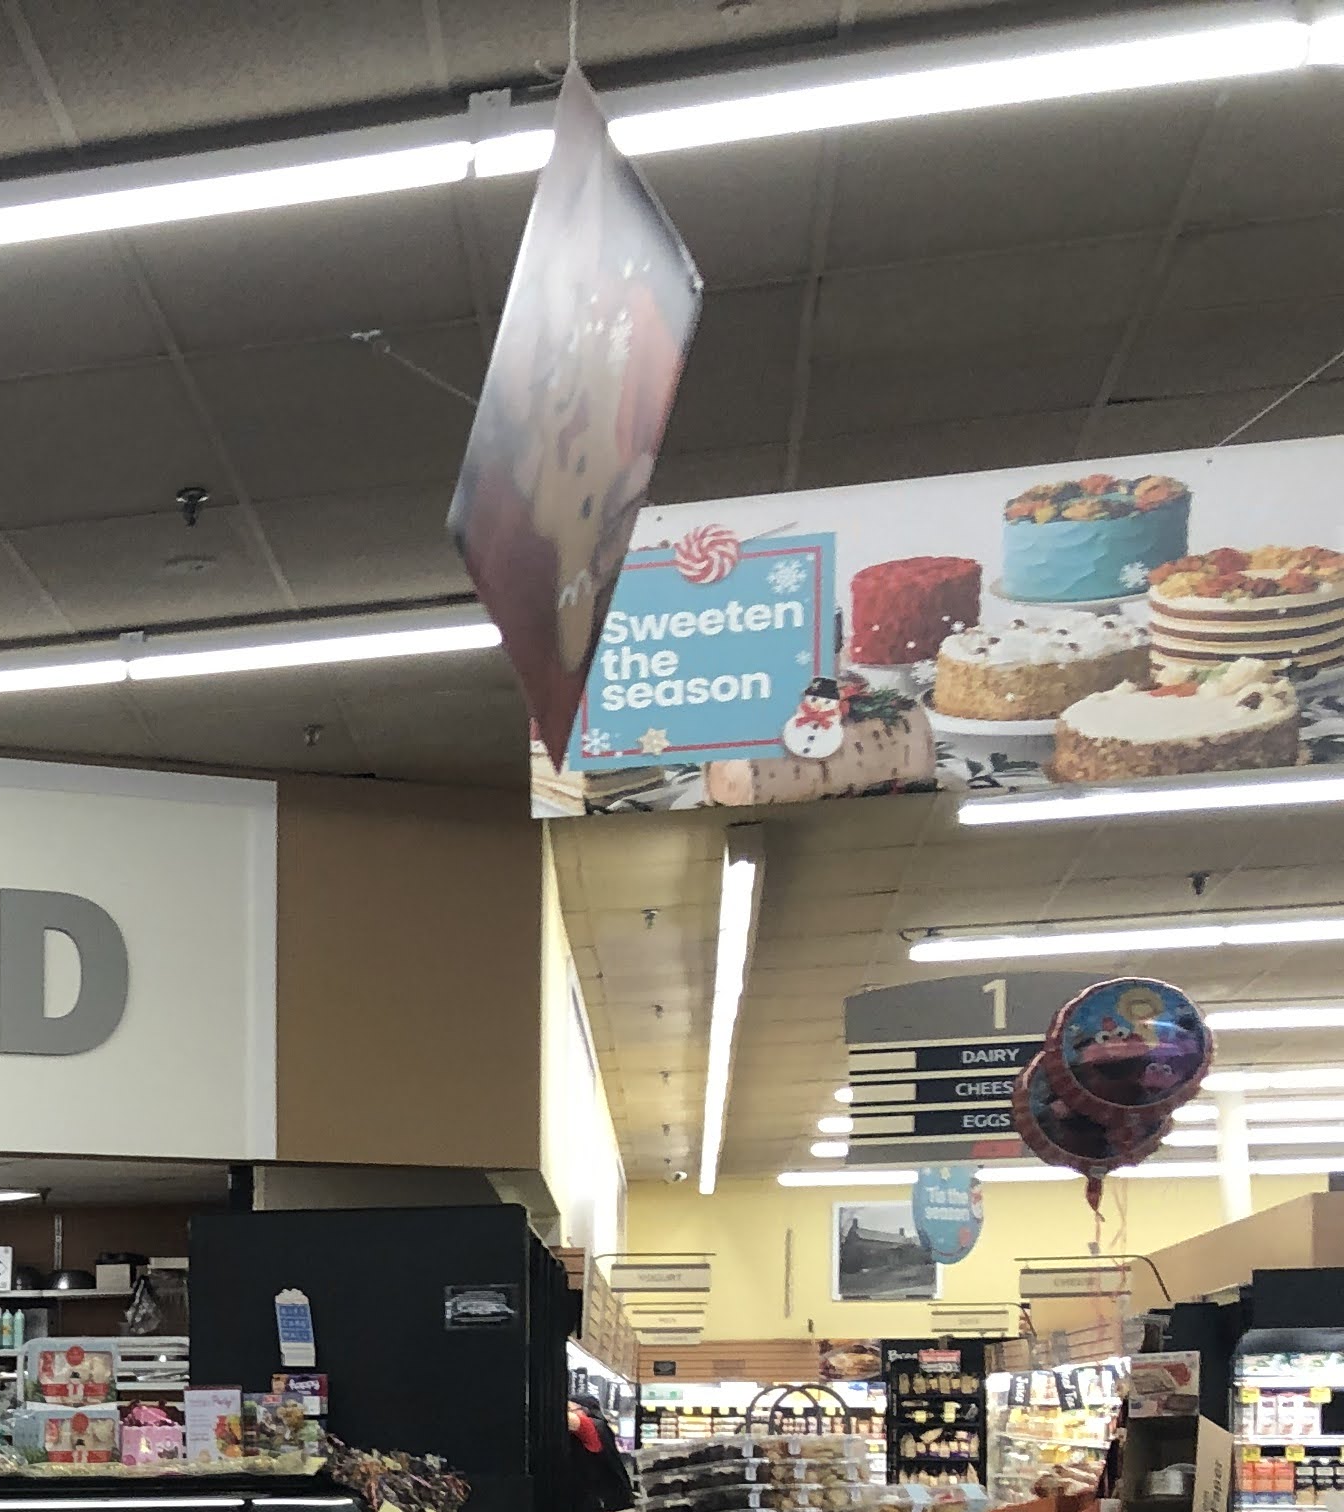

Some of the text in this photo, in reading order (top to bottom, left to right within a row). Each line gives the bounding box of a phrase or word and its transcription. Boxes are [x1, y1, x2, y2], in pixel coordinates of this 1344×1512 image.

[601, 600, 804, 644] Sweeten
[599, 646, 680, 681] the
[600, 672, 772, 712] season
[982, 979, 1008, 1030] 1
[962, 1048, 1020, 1064] DAIRY
[962, 1113, 1011, 1128] EGGS
